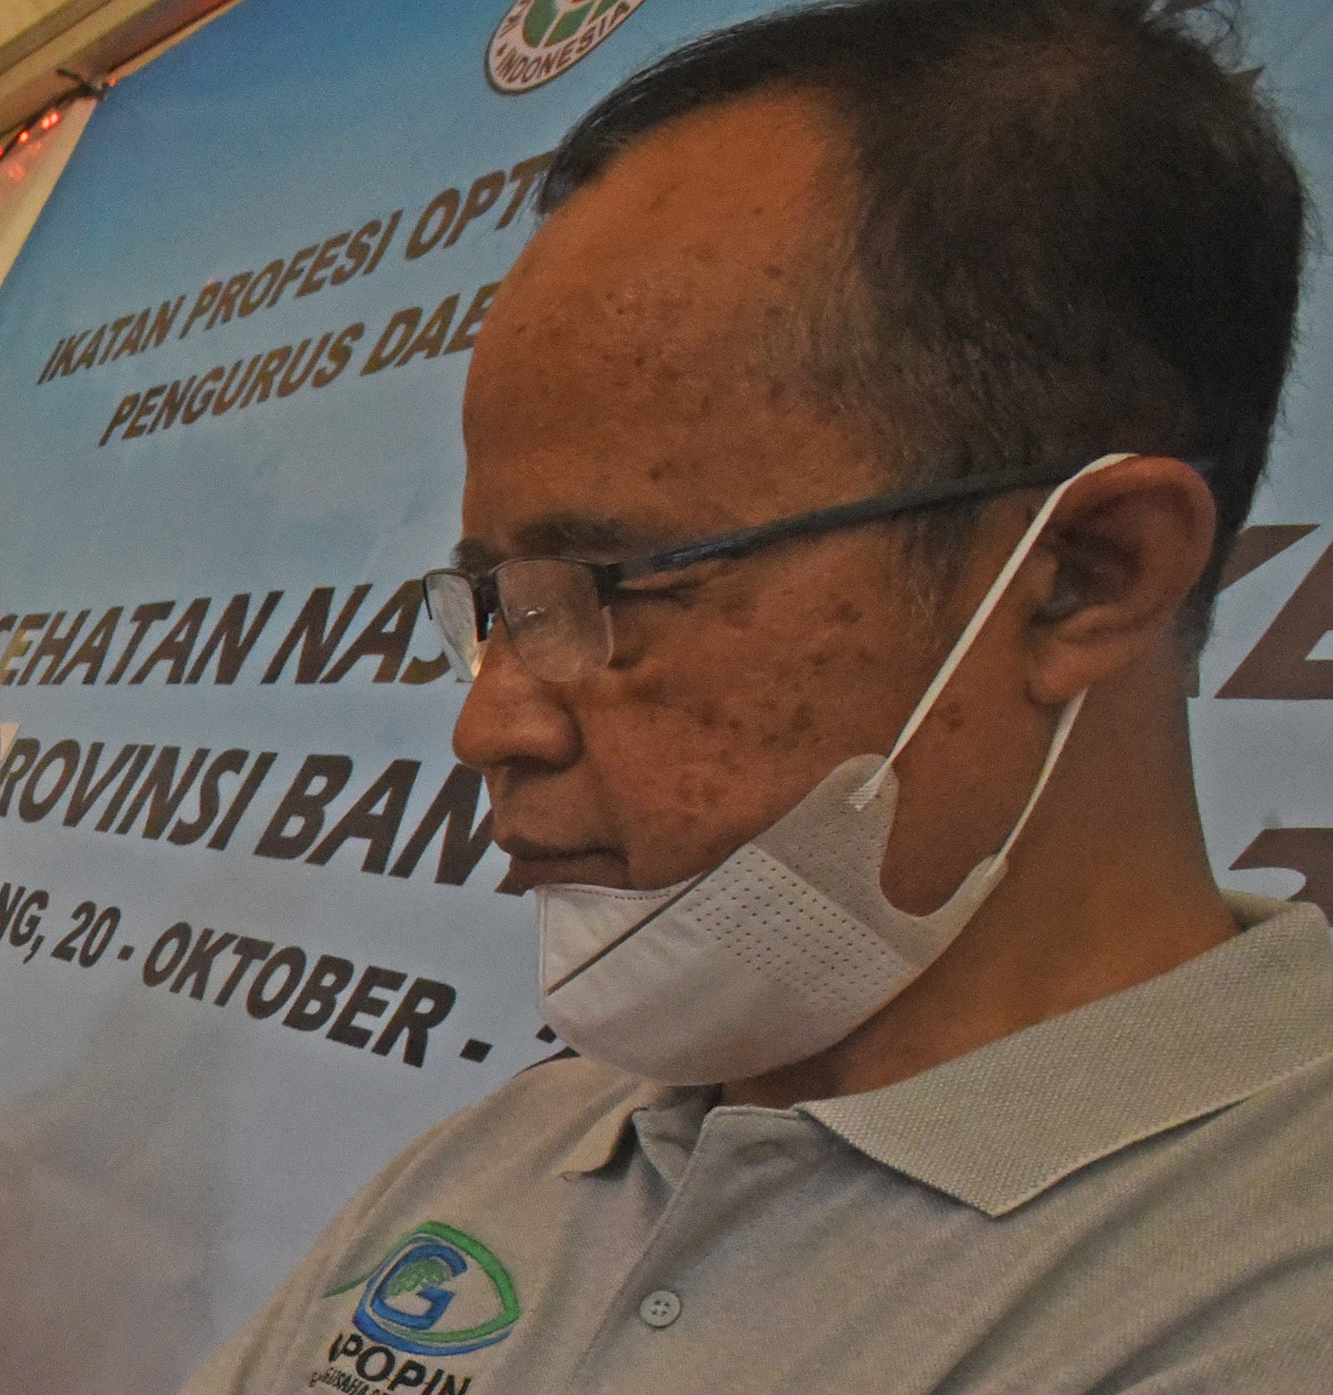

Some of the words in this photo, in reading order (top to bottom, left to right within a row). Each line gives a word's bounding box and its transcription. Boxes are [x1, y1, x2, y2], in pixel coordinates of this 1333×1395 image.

[36, 294, 186, 386] IKATAN
[179, 209, 404, 340] PROFESI
[98, 321, 365, 448] PENGURUS
[50, 901, 122, 968] 20
[142, 921, 458, 1068] OKTOBER
